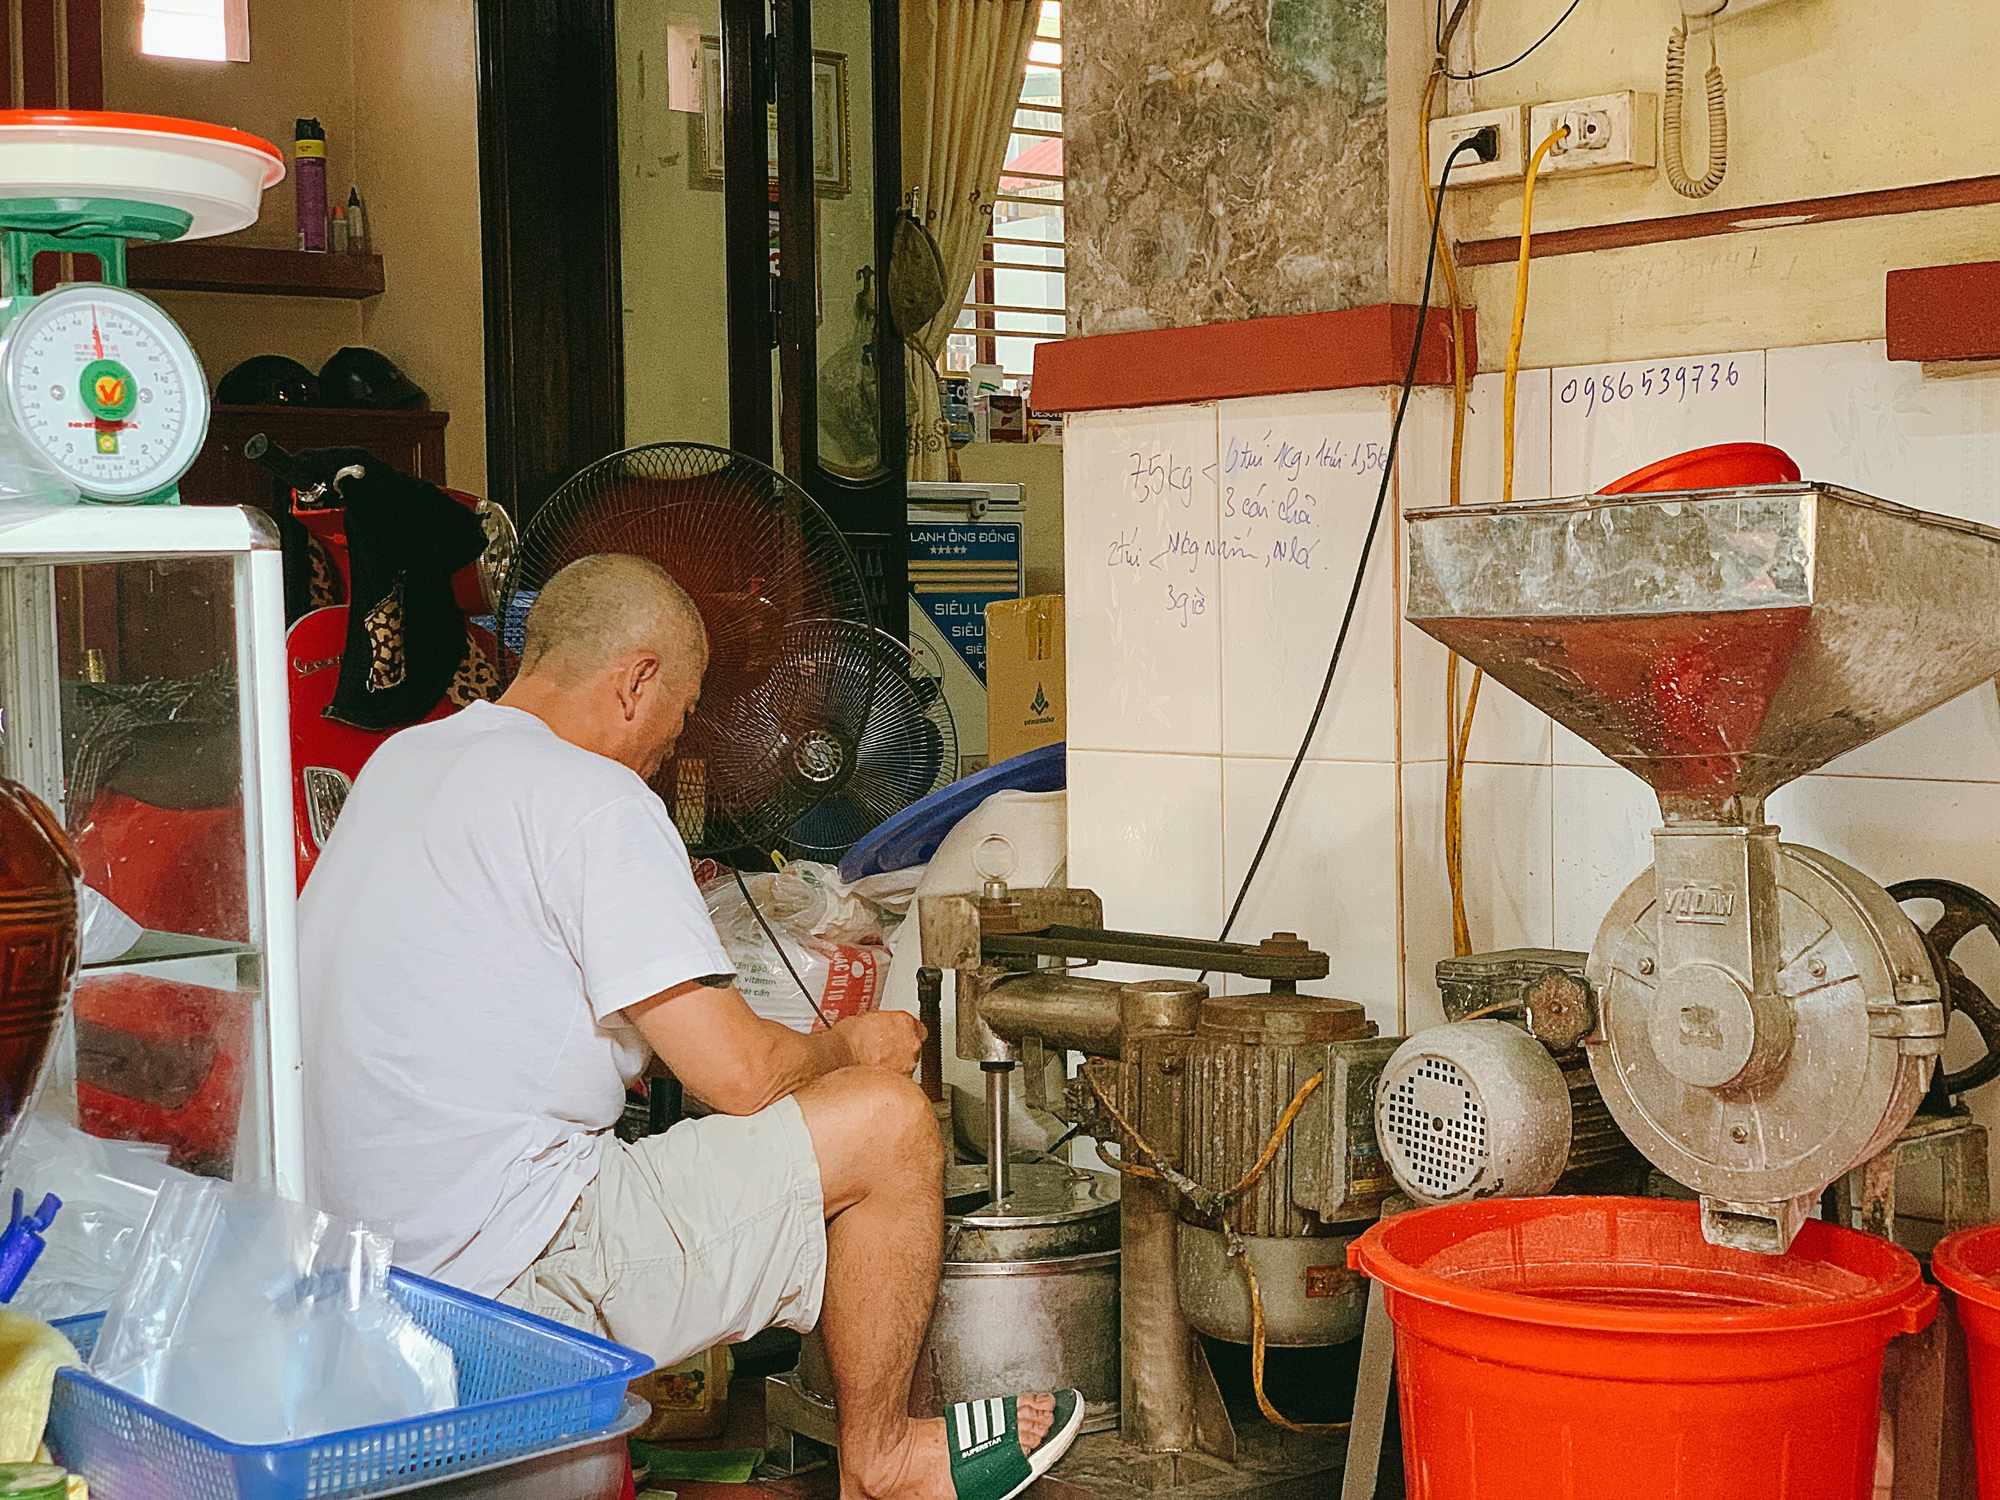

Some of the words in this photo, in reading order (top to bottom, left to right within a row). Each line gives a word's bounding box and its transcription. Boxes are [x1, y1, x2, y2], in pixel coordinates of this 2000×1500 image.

[1561, 361, 1739, 418] 0986539736
[66, 443, 74, 453] 3
[141, 444, 149, 454] 2
[1226, 486, 1236, 518] 3
[910, 532, 946, 545] LẠNH
[934, 599, 970, 616] SIÊU
[952, 622, 984, 637] SIÊU
[827, 989, 846, 1001] 10
[961, 1436, 1002, 1459] SUPERSTAR
